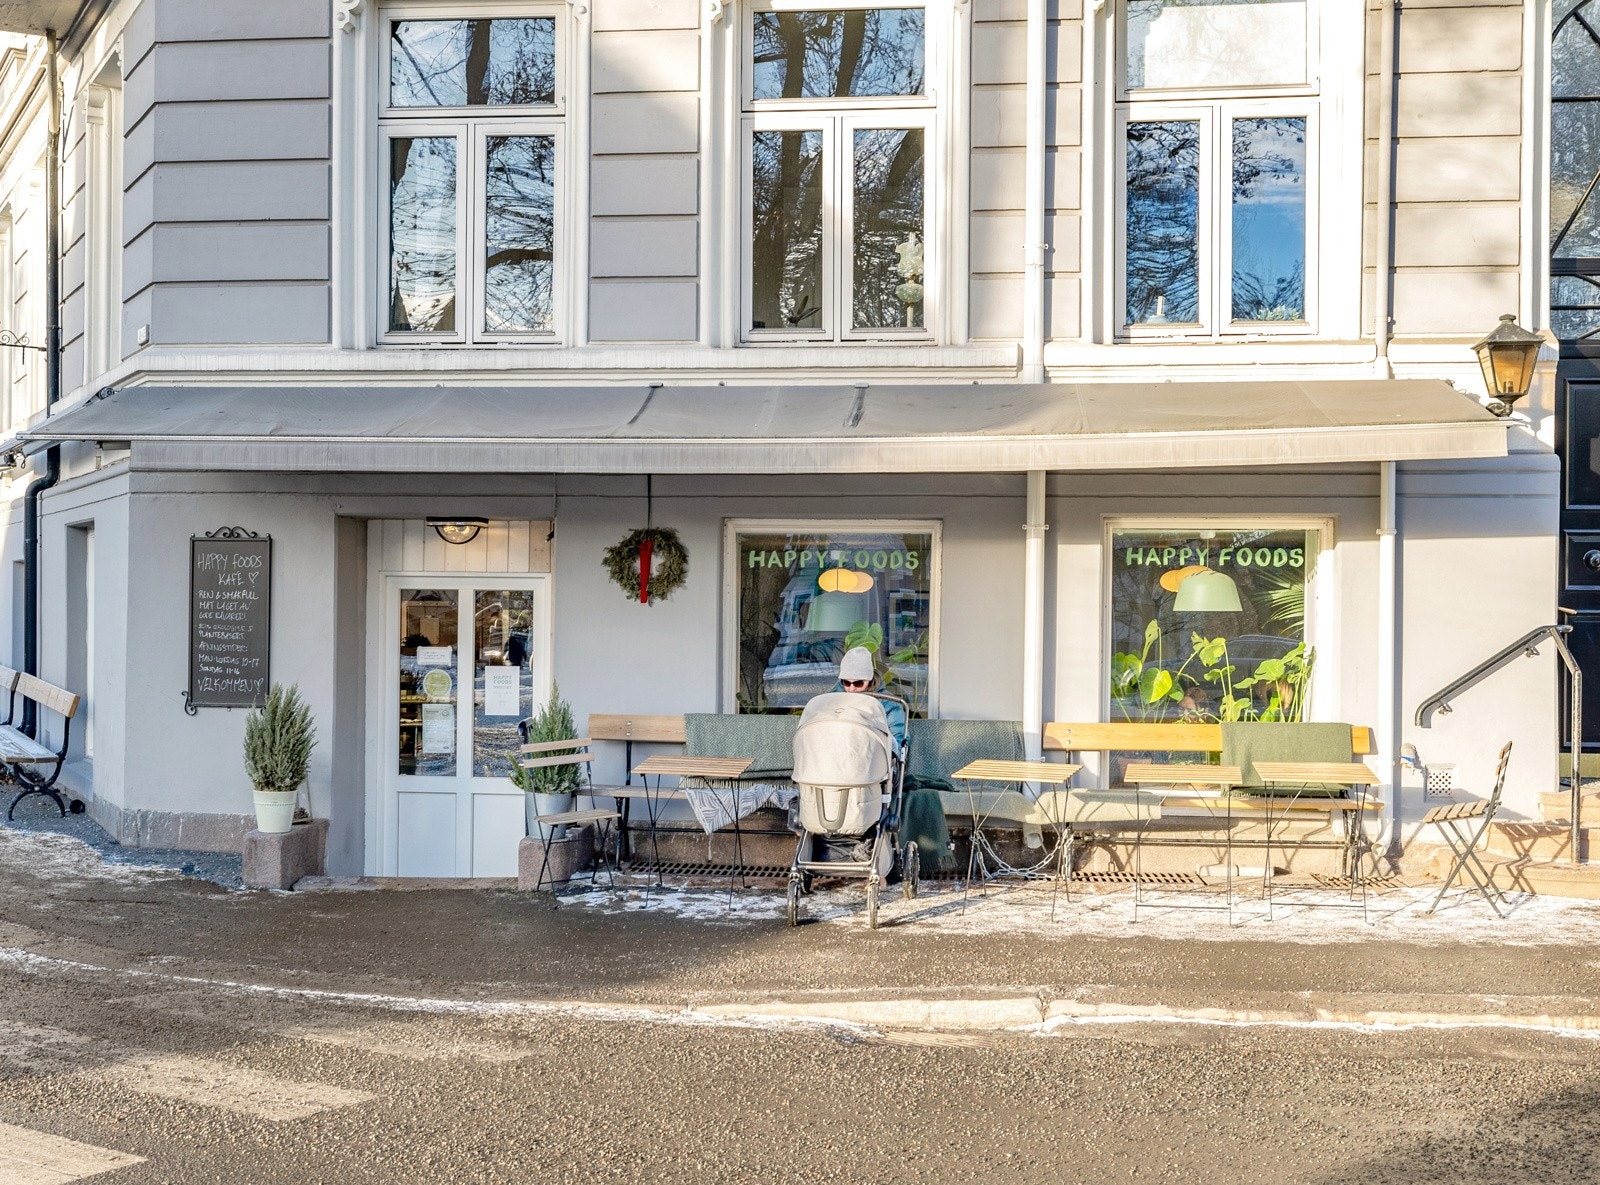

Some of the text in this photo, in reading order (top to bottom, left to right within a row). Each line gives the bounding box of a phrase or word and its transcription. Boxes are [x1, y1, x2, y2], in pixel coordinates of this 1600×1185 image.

[197, 553, 228, 571] HAPPY
[748, 550, 919, 570] HAPPY FOODS
[1126, 547, 1304, 568] HAPPY FOODS
[199, 589, 214, 599] REN
[222, 589, 259, 600] SMAKFULL
[199, 601, 252, 611] MAT LAGET AV
[197, 676, 253, 692] VELKOMMEN
